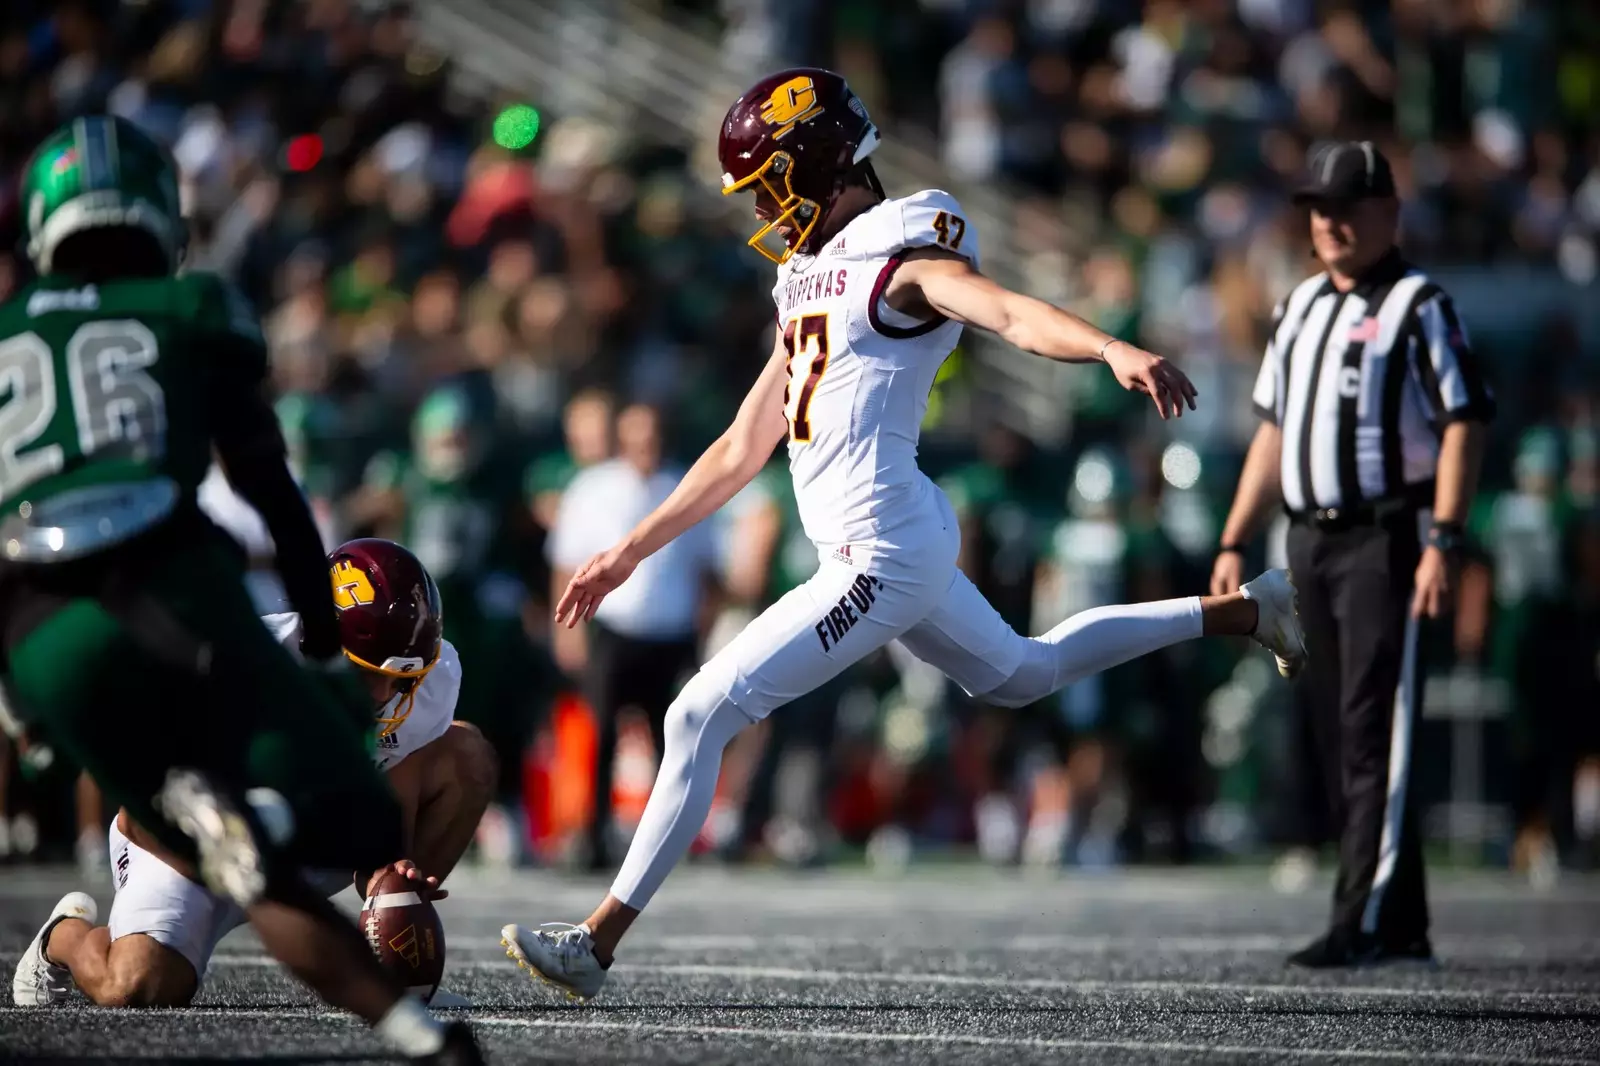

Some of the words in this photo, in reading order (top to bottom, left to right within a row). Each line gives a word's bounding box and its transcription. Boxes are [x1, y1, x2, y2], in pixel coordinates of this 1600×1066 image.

[932, 210, 966, 251] 47
[785, 269, 848, 311] HIPPEWAS
[0, 319, 168, 504] 26
[815, 596, 858, 653] FIRE
